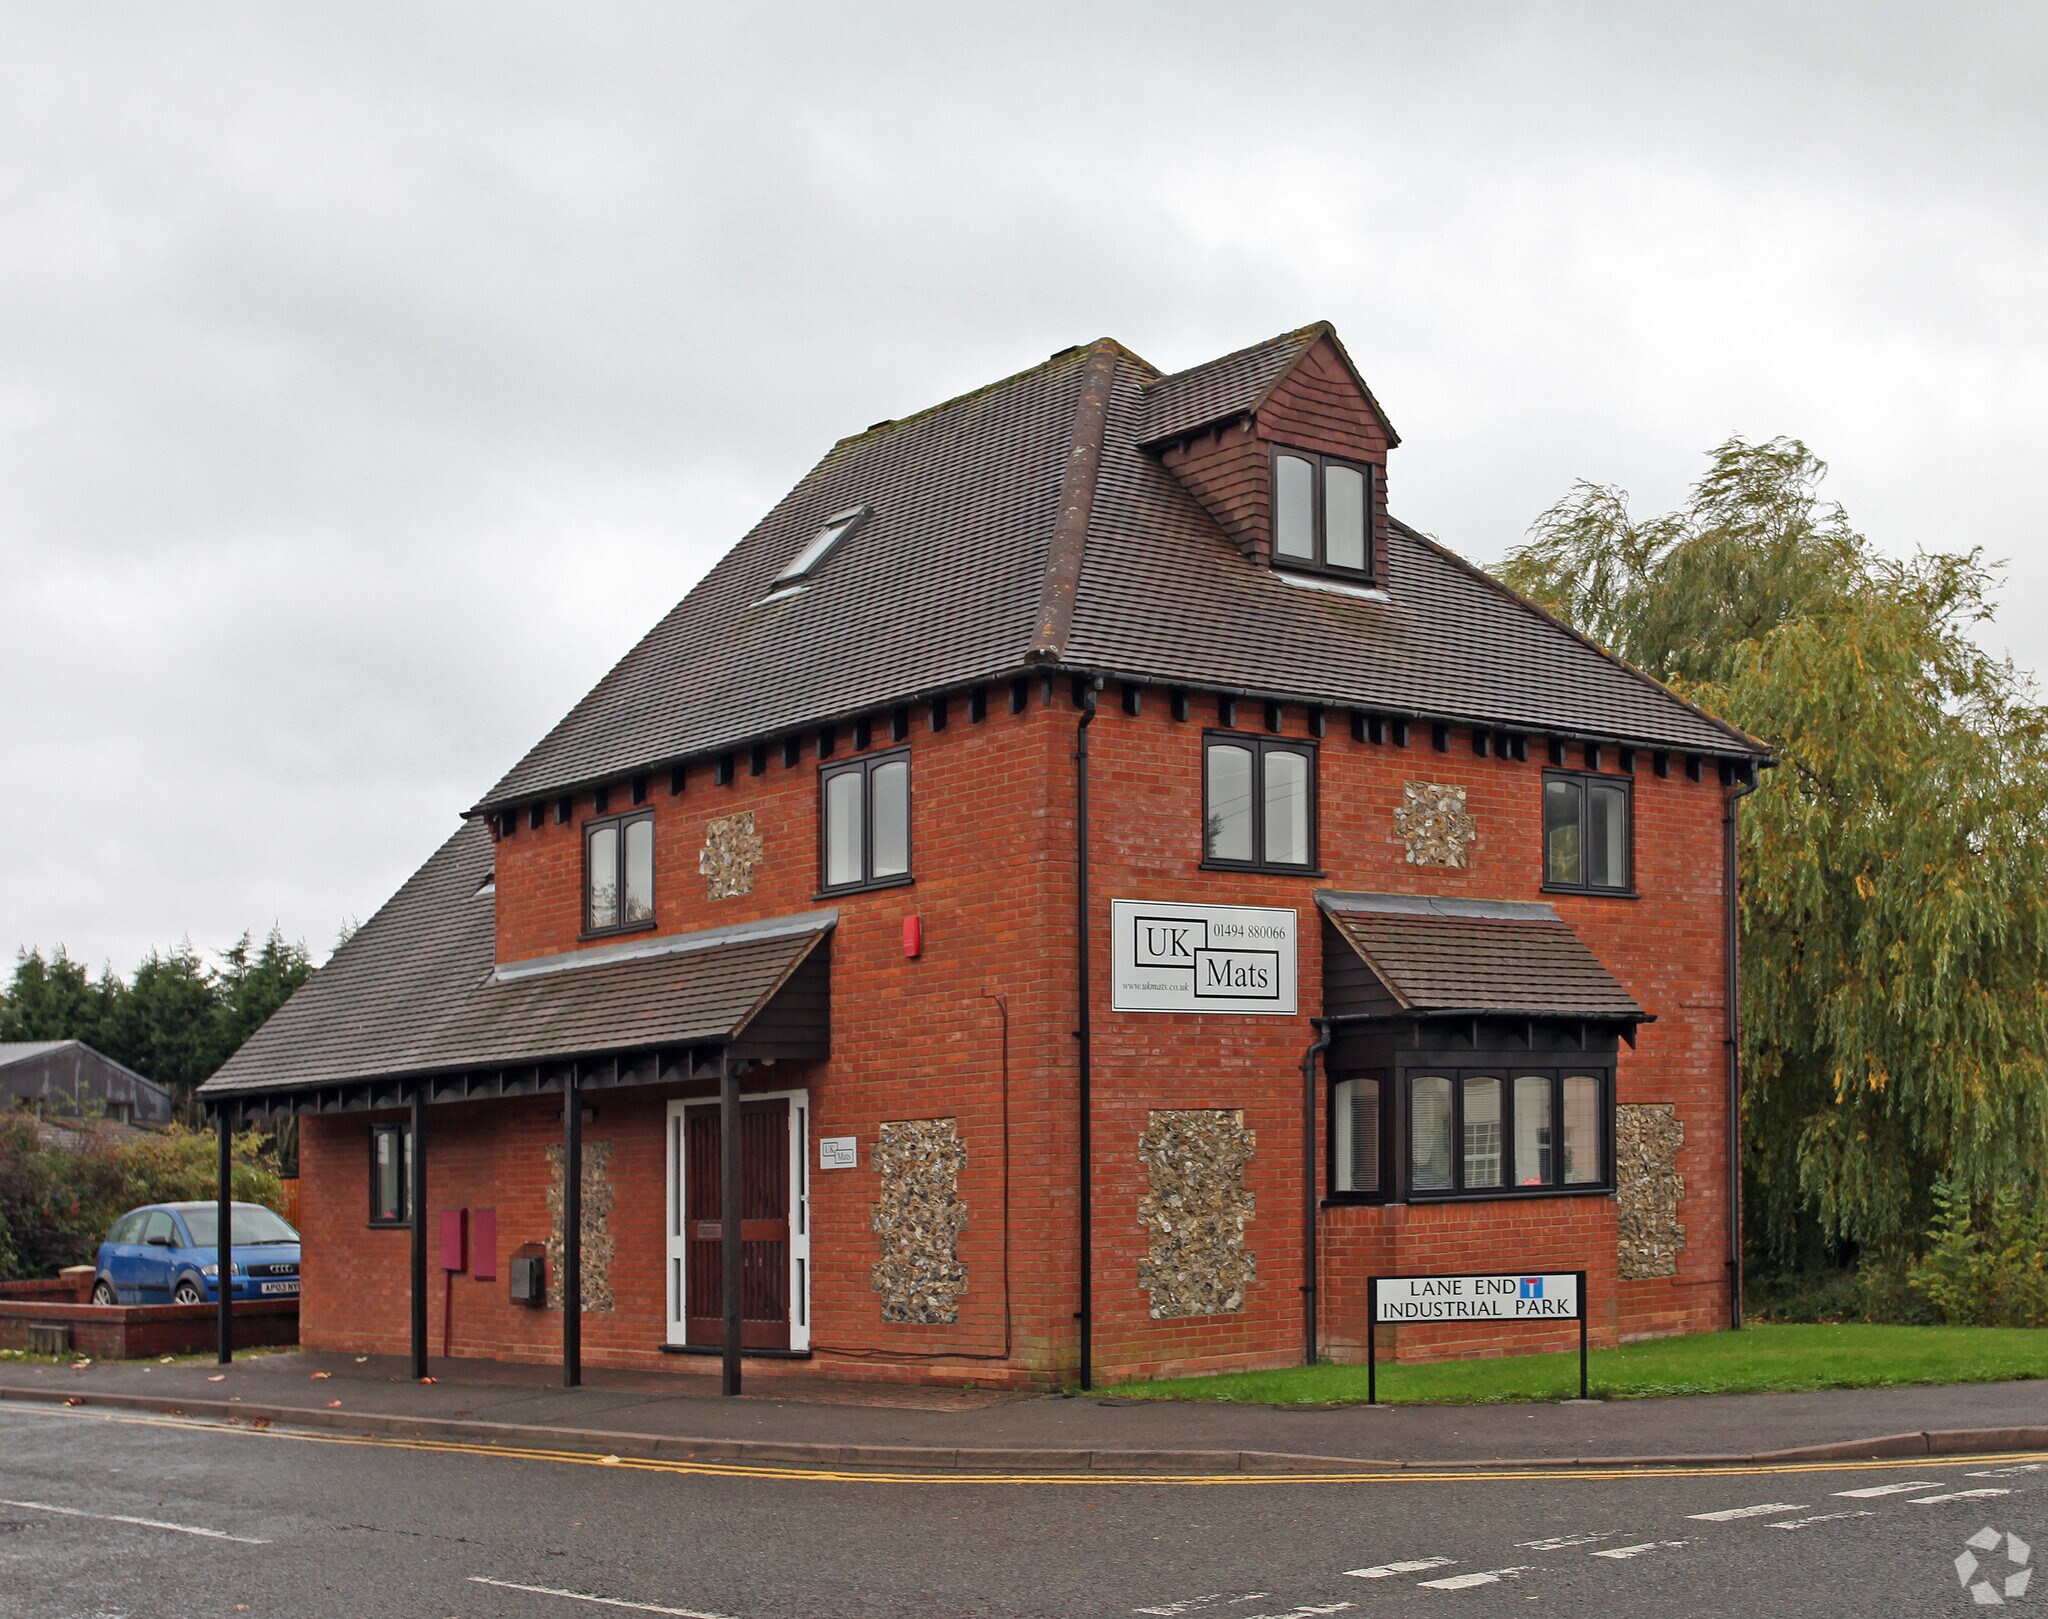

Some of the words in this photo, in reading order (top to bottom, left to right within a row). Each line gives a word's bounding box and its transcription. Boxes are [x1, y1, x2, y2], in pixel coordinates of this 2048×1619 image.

[1213, 923, 1245, 938] 01494
[1247, 925, 1286, 940] 880066
[1145, 927, 1192, 958] UK
[1206, 958, 1268, 989] Mats
[1122, 981, 1189, 992] www.ukmats.co.uk
[824, 1145, 836, 1154] UK
[1410, 1280, 1463, 1297] LANE
[1475, 1279, 1516, 1295] END
[1383, 1300, 1502, 1318] INDUSTRIAL
[1515, 1298, 1570, 1315] PARK
